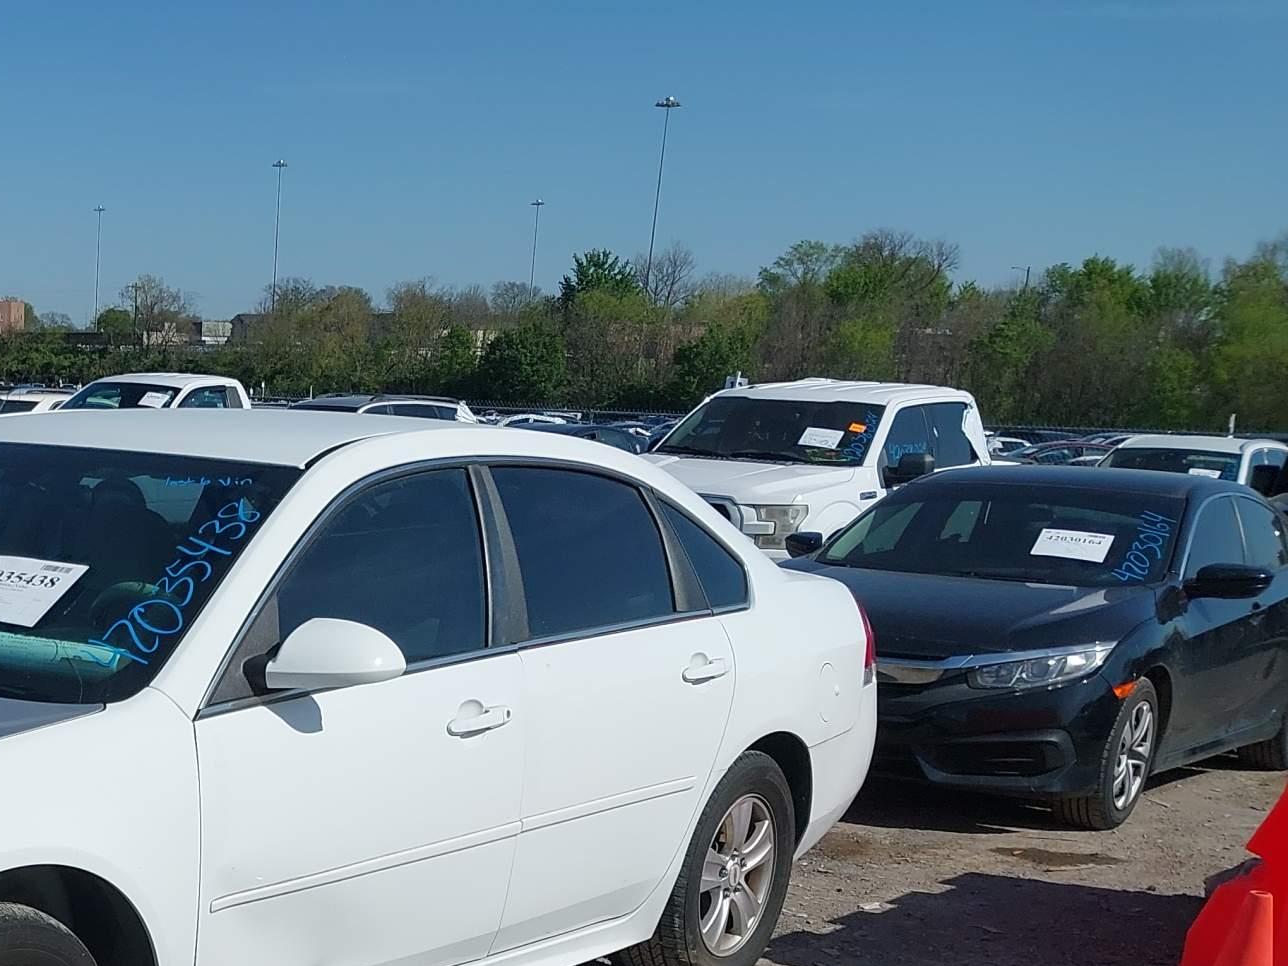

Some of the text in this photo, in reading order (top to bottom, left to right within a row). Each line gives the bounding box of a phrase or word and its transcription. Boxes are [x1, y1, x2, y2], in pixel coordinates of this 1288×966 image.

[1046, 535, 1103, 545] 42030164
[1112, 510, 1176, 581] 42030164
[88, 497, 260, 666] 42035438
